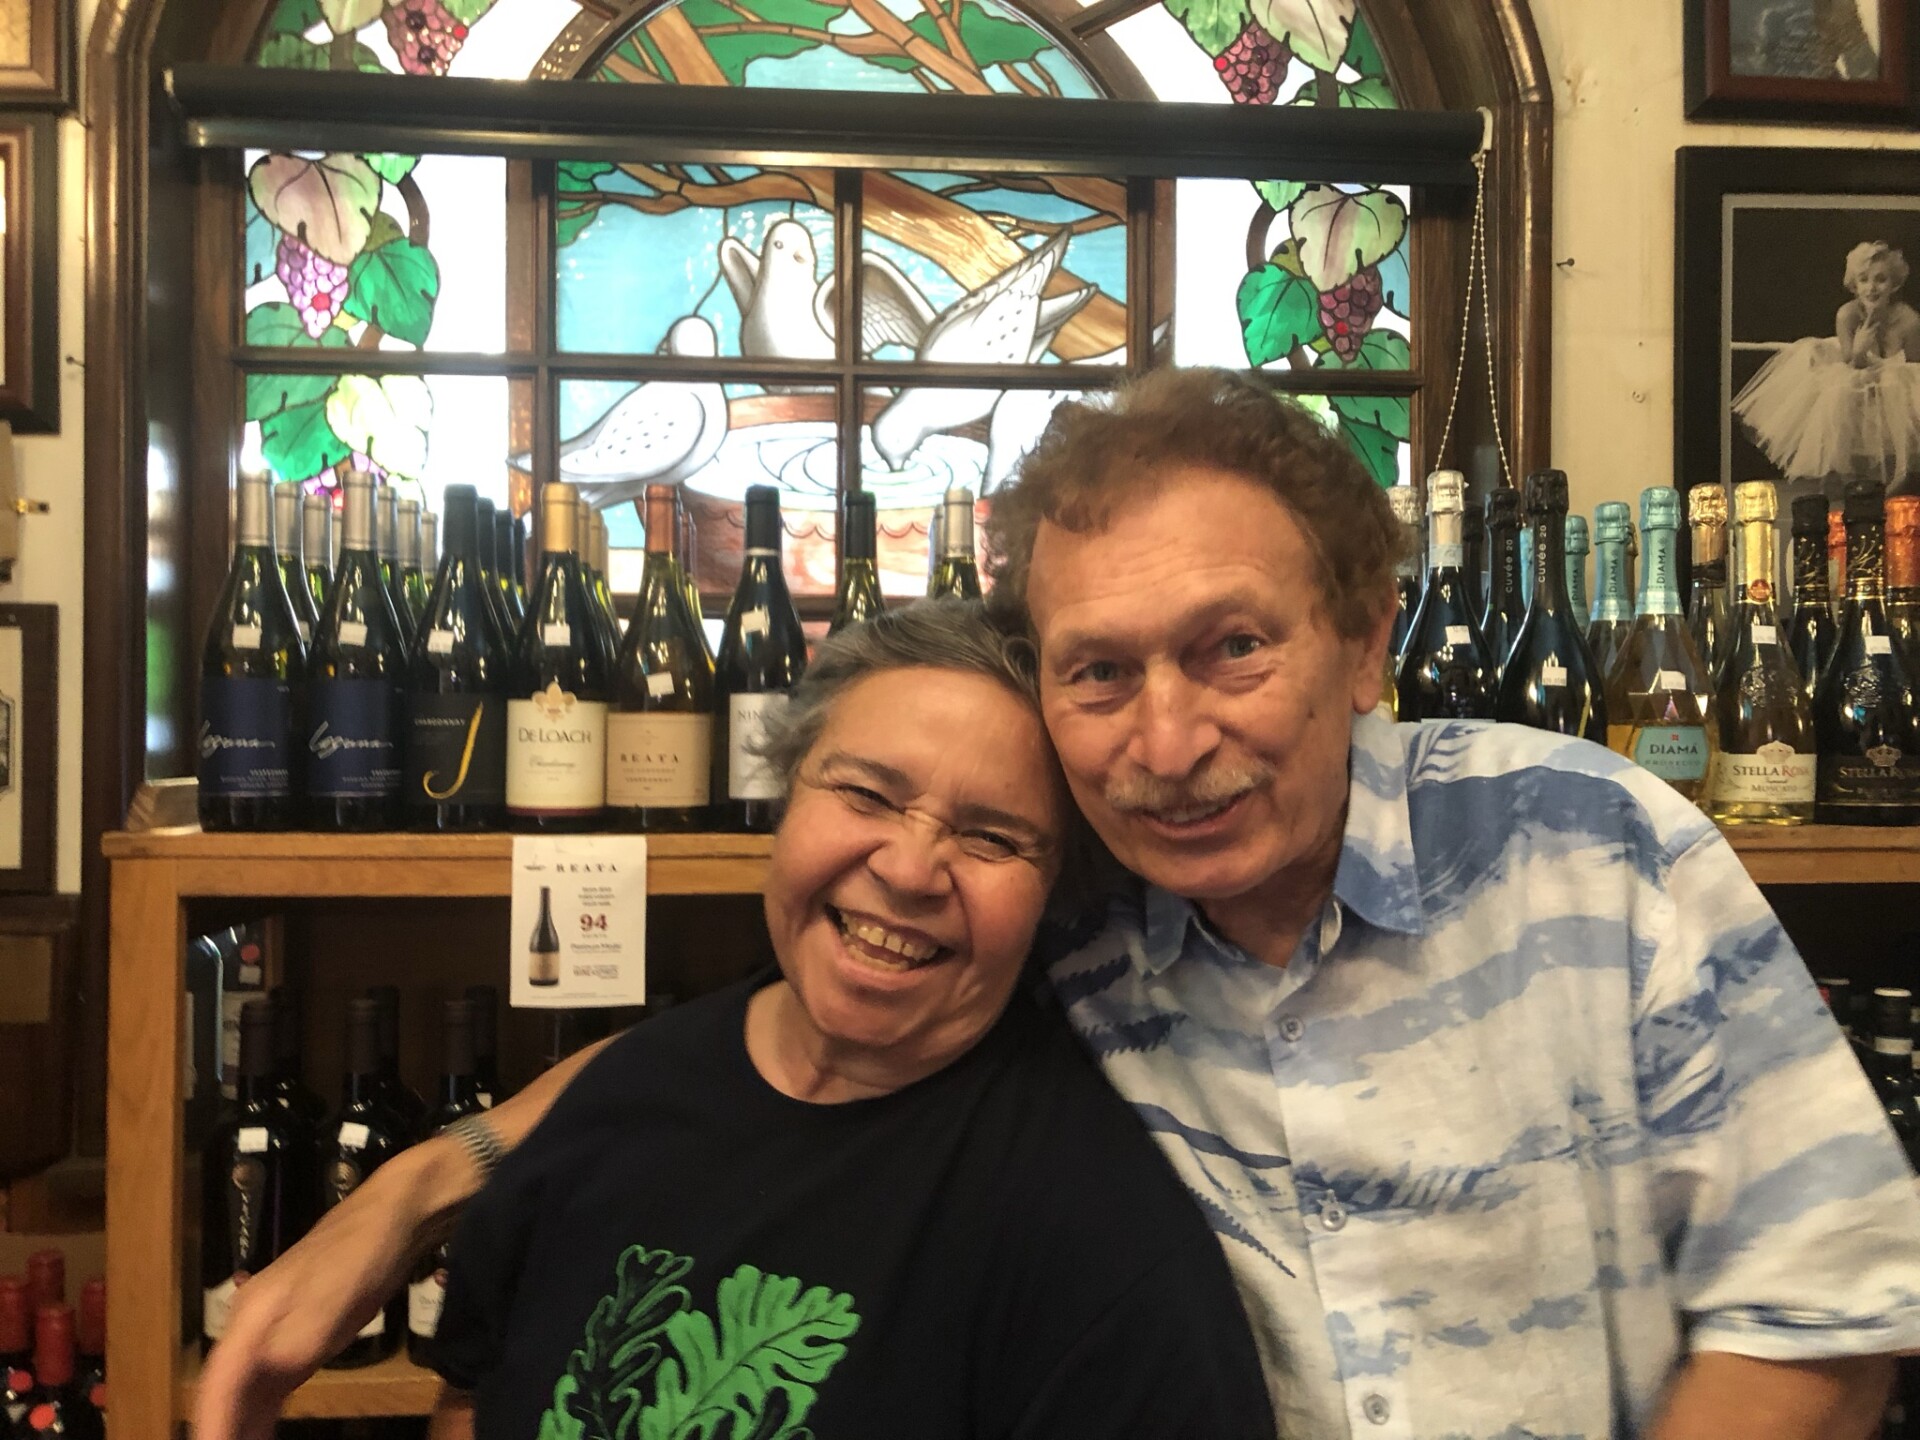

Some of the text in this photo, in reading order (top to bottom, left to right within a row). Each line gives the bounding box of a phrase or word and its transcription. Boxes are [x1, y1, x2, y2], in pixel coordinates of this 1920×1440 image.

[1540, 525, 1547, 538] 20
[1506, 539, 1513, 551] 20
[620, 753, 680, 764] REATA
[1732, 765, 1780, 777] STELLA
[556, 863, 618, 873] REATA
[580, 914, 608, 931] 94
